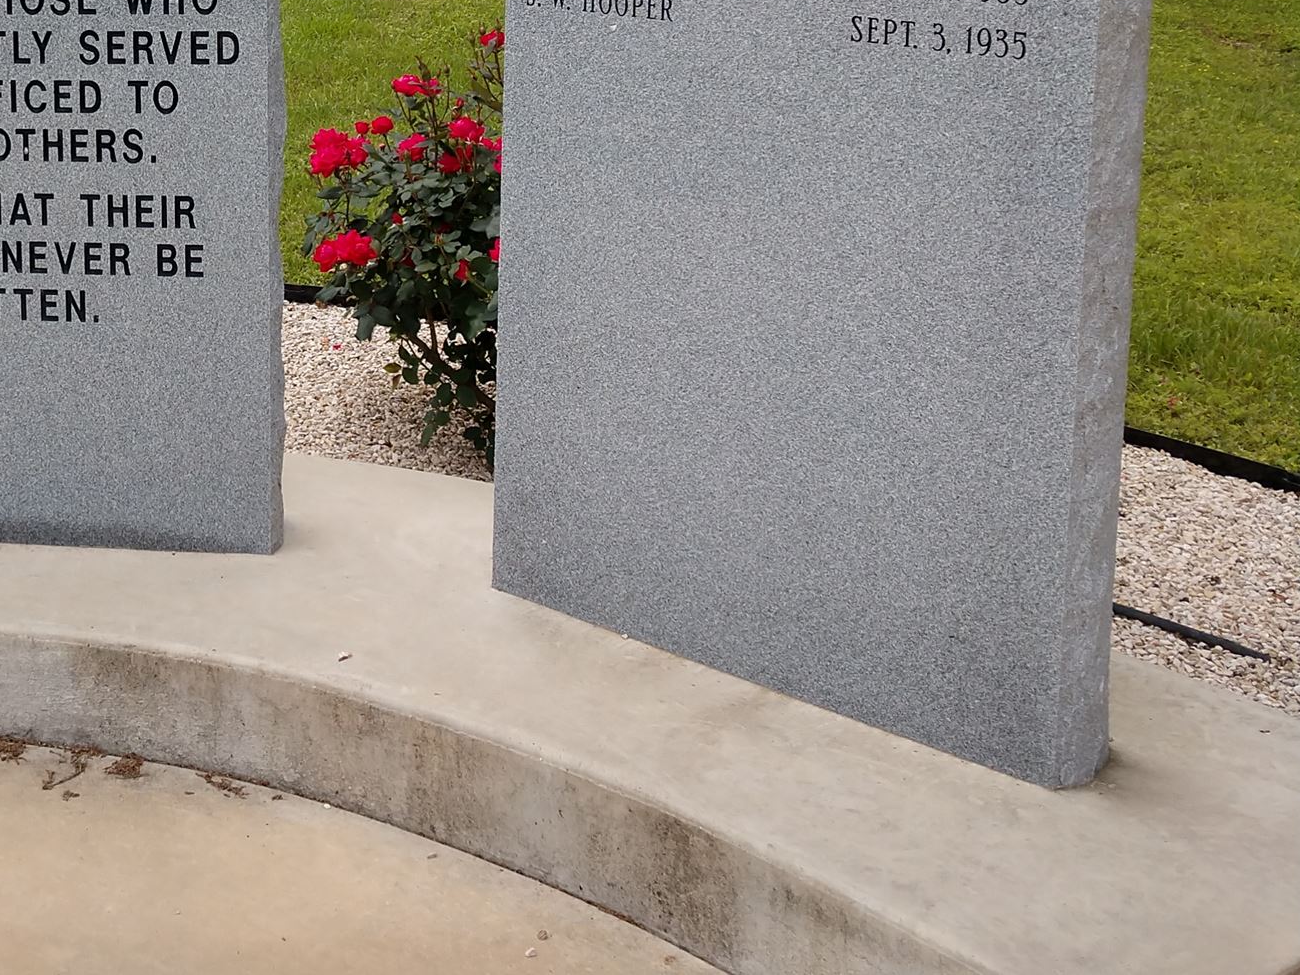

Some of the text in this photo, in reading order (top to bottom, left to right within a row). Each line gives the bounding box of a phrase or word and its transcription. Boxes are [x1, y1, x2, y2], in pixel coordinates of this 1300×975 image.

[78, 29, 240, 66] SERVED
[850, 15, 1028, 61] SEPT. 3, 1935
[126, 79, 179, 116] TO
[79, 193, 197, 230] THEIR
[1, 240, 132, 277] NEVER
[156, 243, 205, 278] BE
